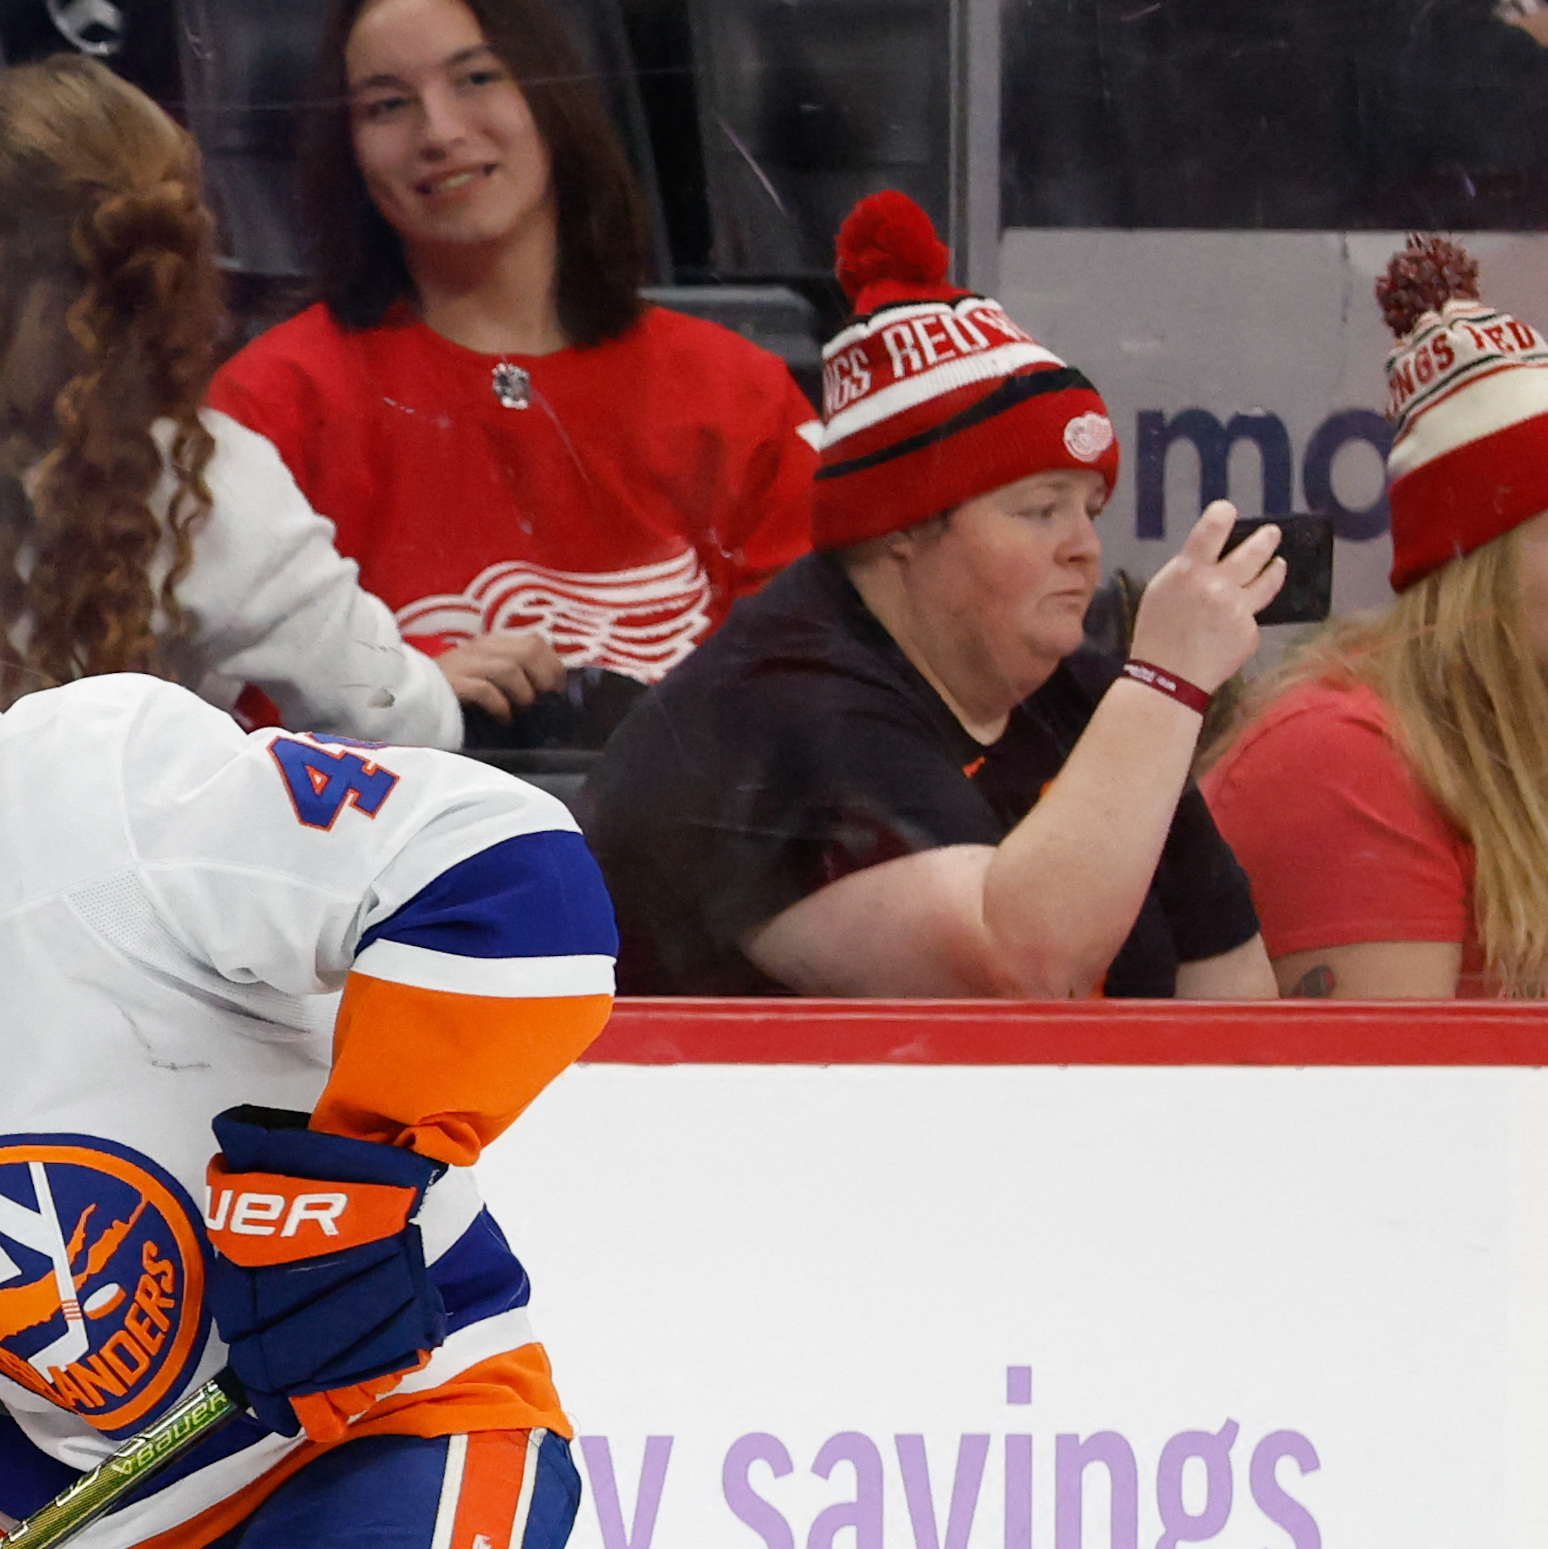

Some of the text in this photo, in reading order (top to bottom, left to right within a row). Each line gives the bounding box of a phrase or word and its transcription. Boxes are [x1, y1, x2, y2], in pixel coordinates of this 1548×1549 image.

[881, 313, 990, 379] RED
[266, 731, 401, 832] 4
[205, 1186, 349, 1239] UER
[0, 1240, 176, 1408] ANDERS
